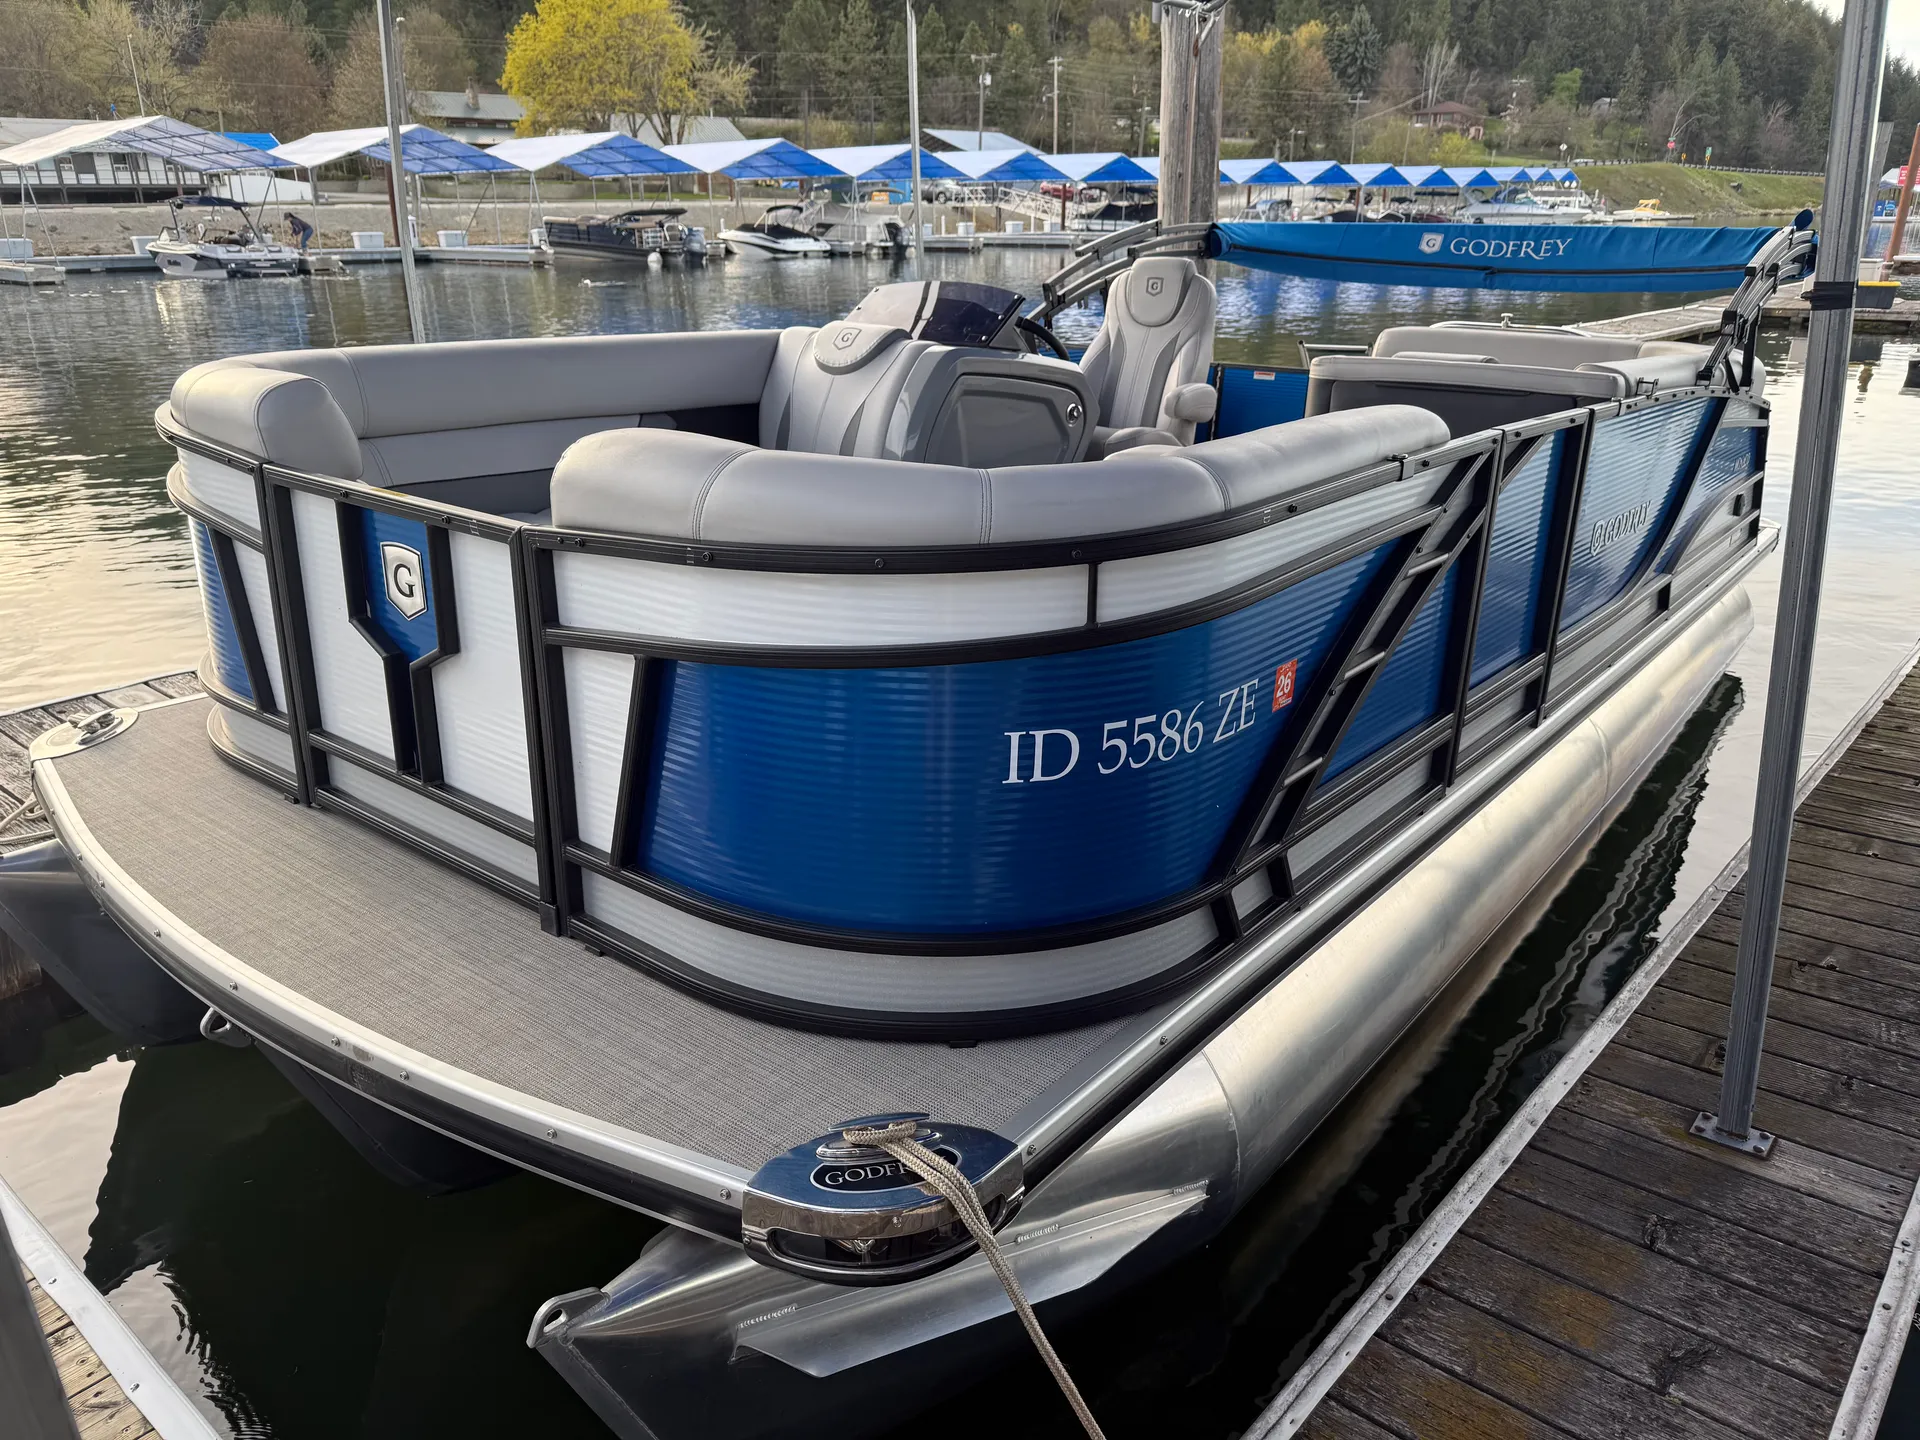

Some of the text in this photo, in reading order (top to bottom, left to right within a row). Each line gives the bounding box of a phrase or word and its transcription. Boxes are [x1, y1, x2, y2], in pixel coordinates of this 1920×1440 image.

[1426, 237, 1573, 260] G GODFREY
[393, 563, 415, 598] G
[1276, 671, 1292, 698] 26
[1001, 678, 1259, 784] ID 5586 ZE
[824, 1160, 911, 1185] GODFR
